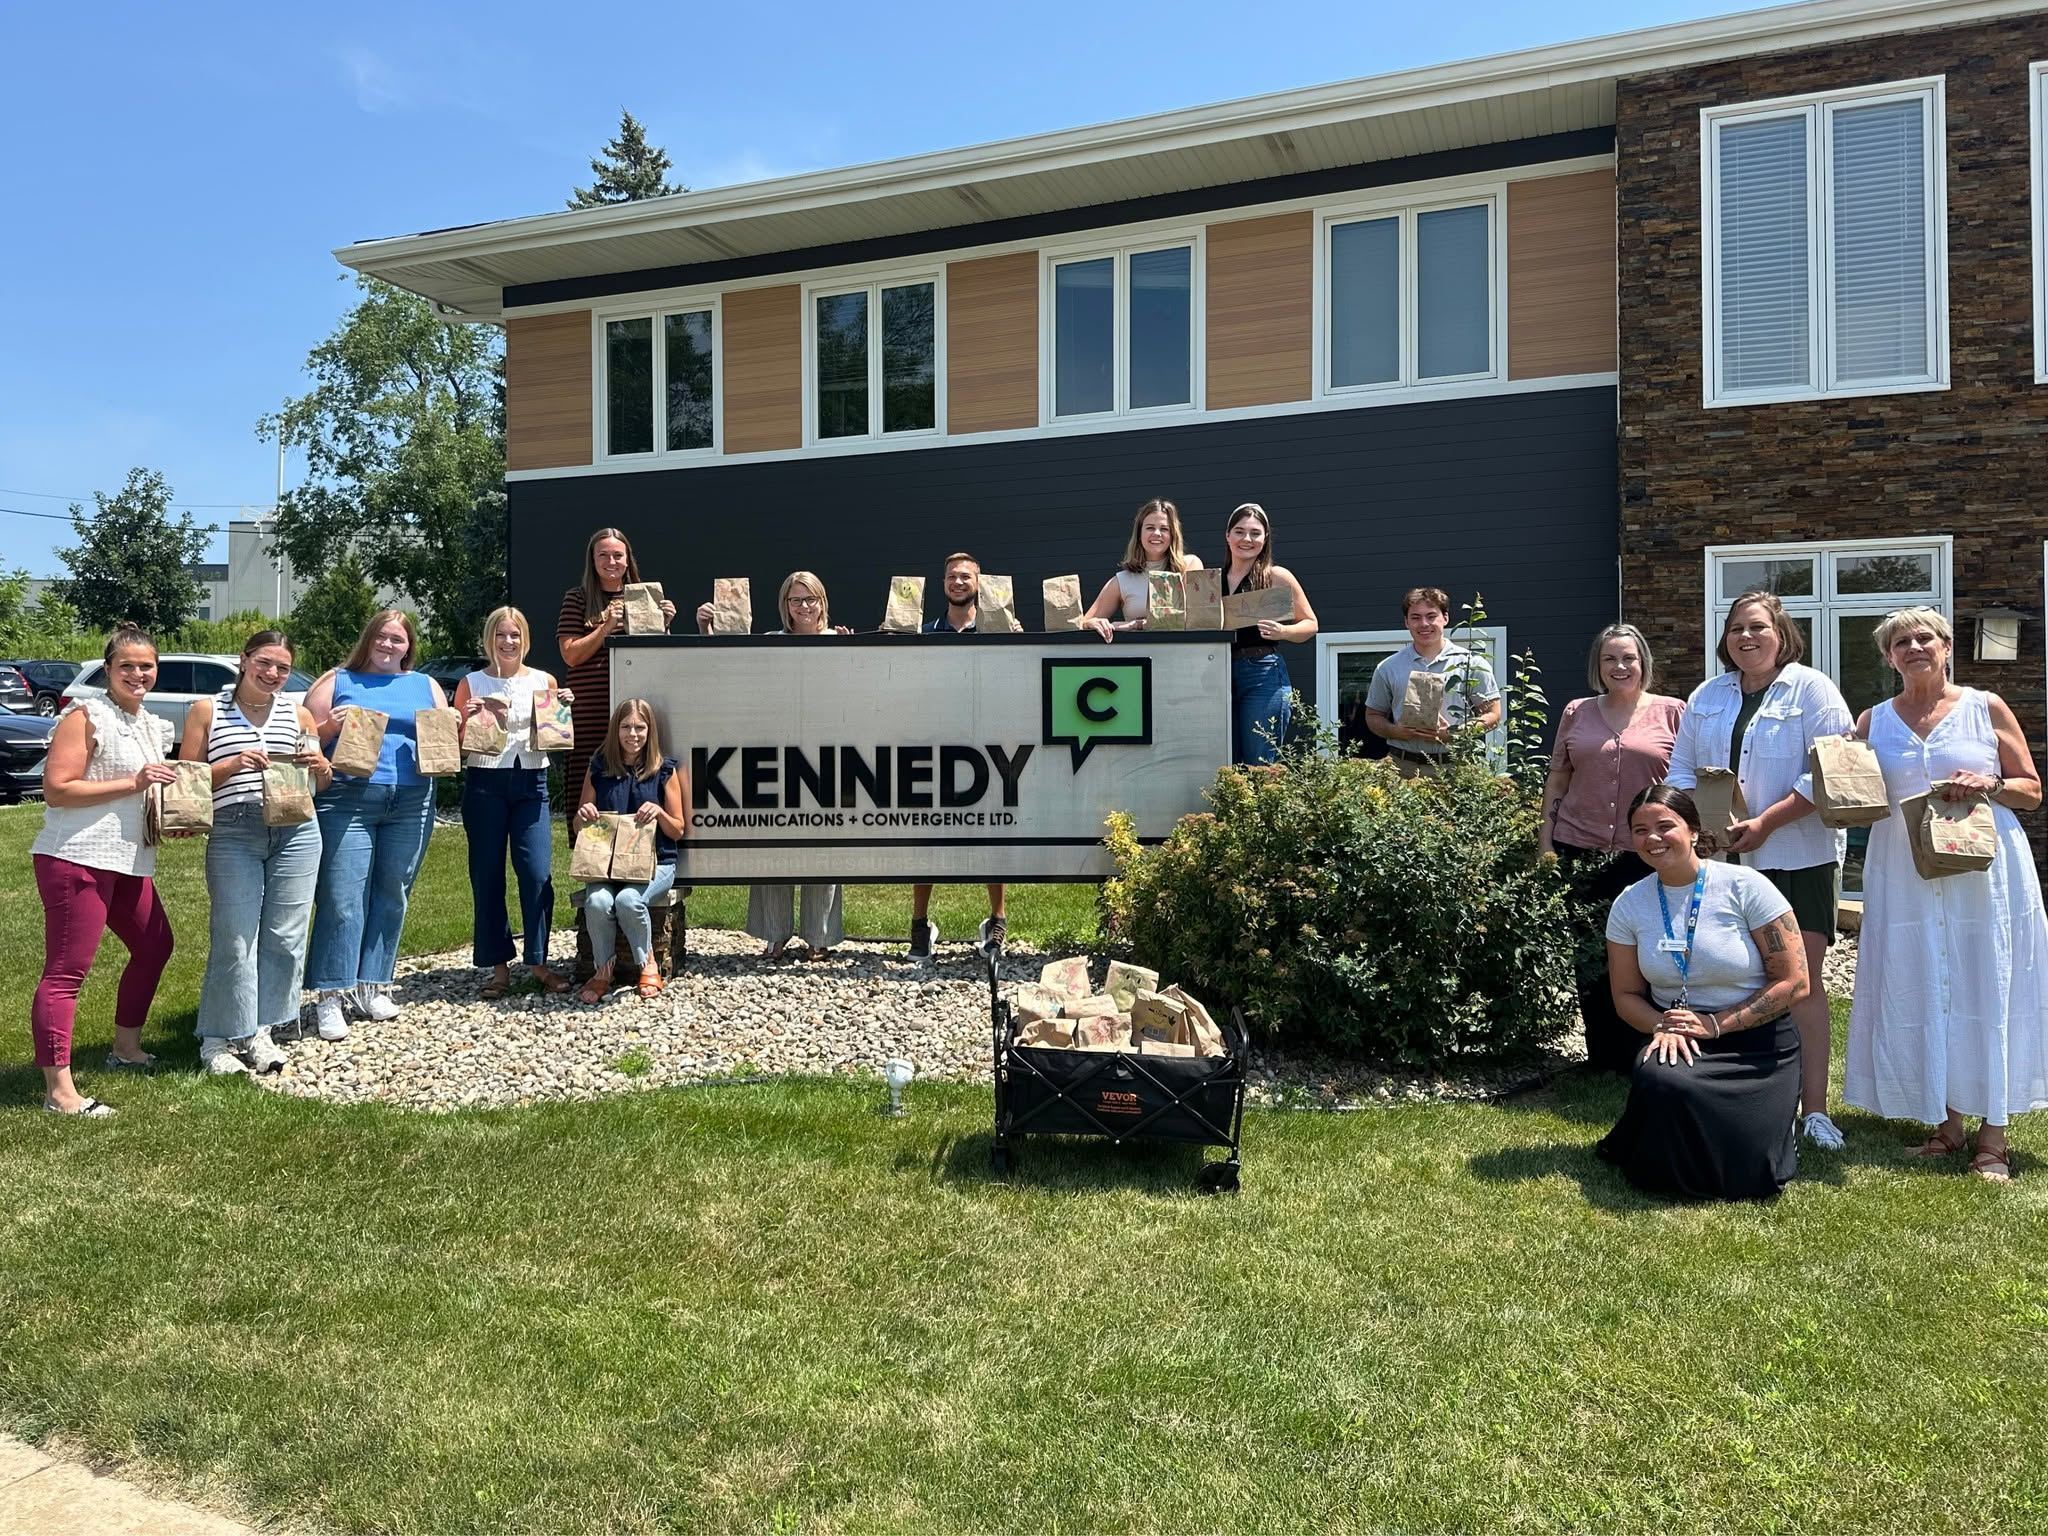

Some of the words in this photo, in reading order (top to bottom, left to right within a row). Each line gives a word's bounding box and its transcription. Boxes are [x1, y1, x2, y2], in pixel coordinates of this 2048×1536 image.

[1076, 677, 1119, 722] C
[692, 745, 1035, 809] KENNEDY
[692, 812, 844, 828] COMMUNICATIONS
[862, 812, 984, 827] CONVERGENCE
[989, 812, 1018, 826] LTD.
[1102, 1091, 1137, 1102] VEVOR
